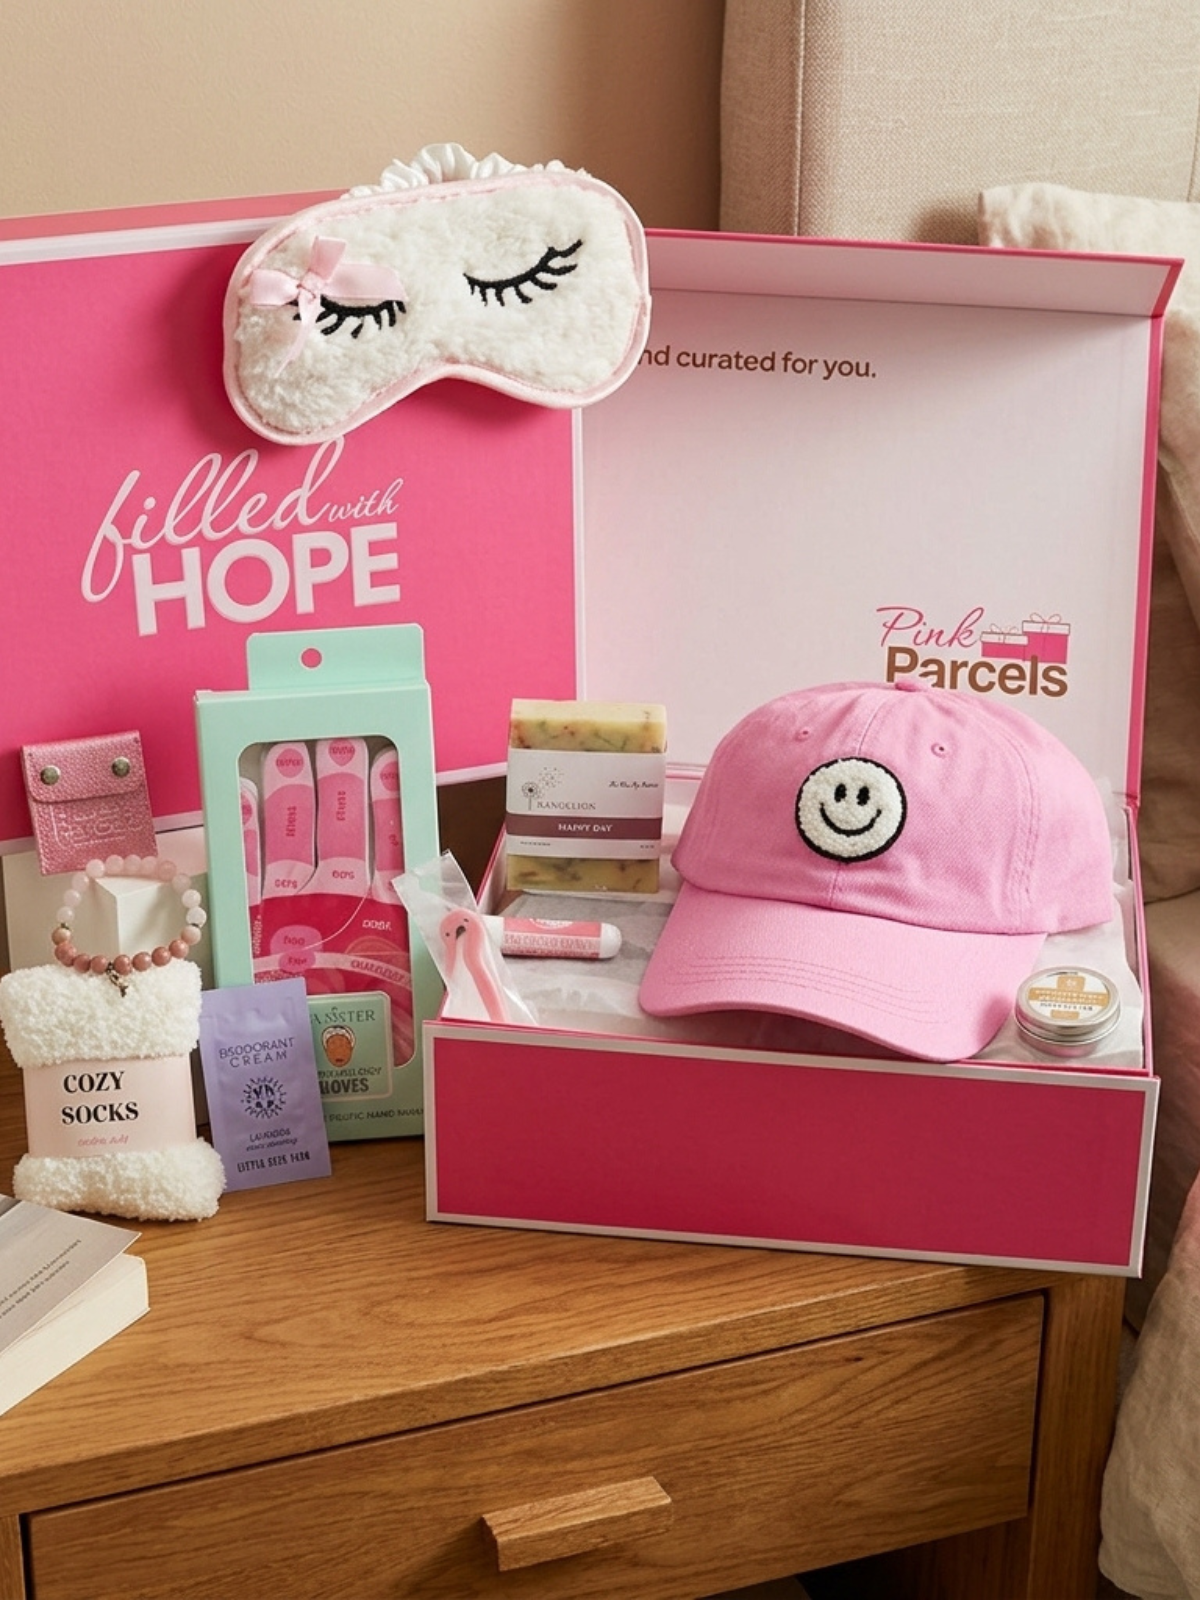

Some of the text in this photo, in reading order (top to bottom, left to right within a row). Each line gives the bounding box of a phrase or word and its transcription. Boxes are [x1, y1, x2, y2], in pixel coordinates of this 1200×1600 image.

[676, 350, 777, 372] curated
[783, 351, 818, 375] for
[822, 358, 877, 381] you.
[81, 434, 404, 603] filled with
[131, 521, 402, 637] HOPE
[876, 606, 985, 648] Pink
[886, 646, 1069, 698] Parcels
[229, 1050, 288, 1068] CREAM
[63, 1070, 125, 1094] COZY
[61, 1101, 139, 1125] SOCKS
